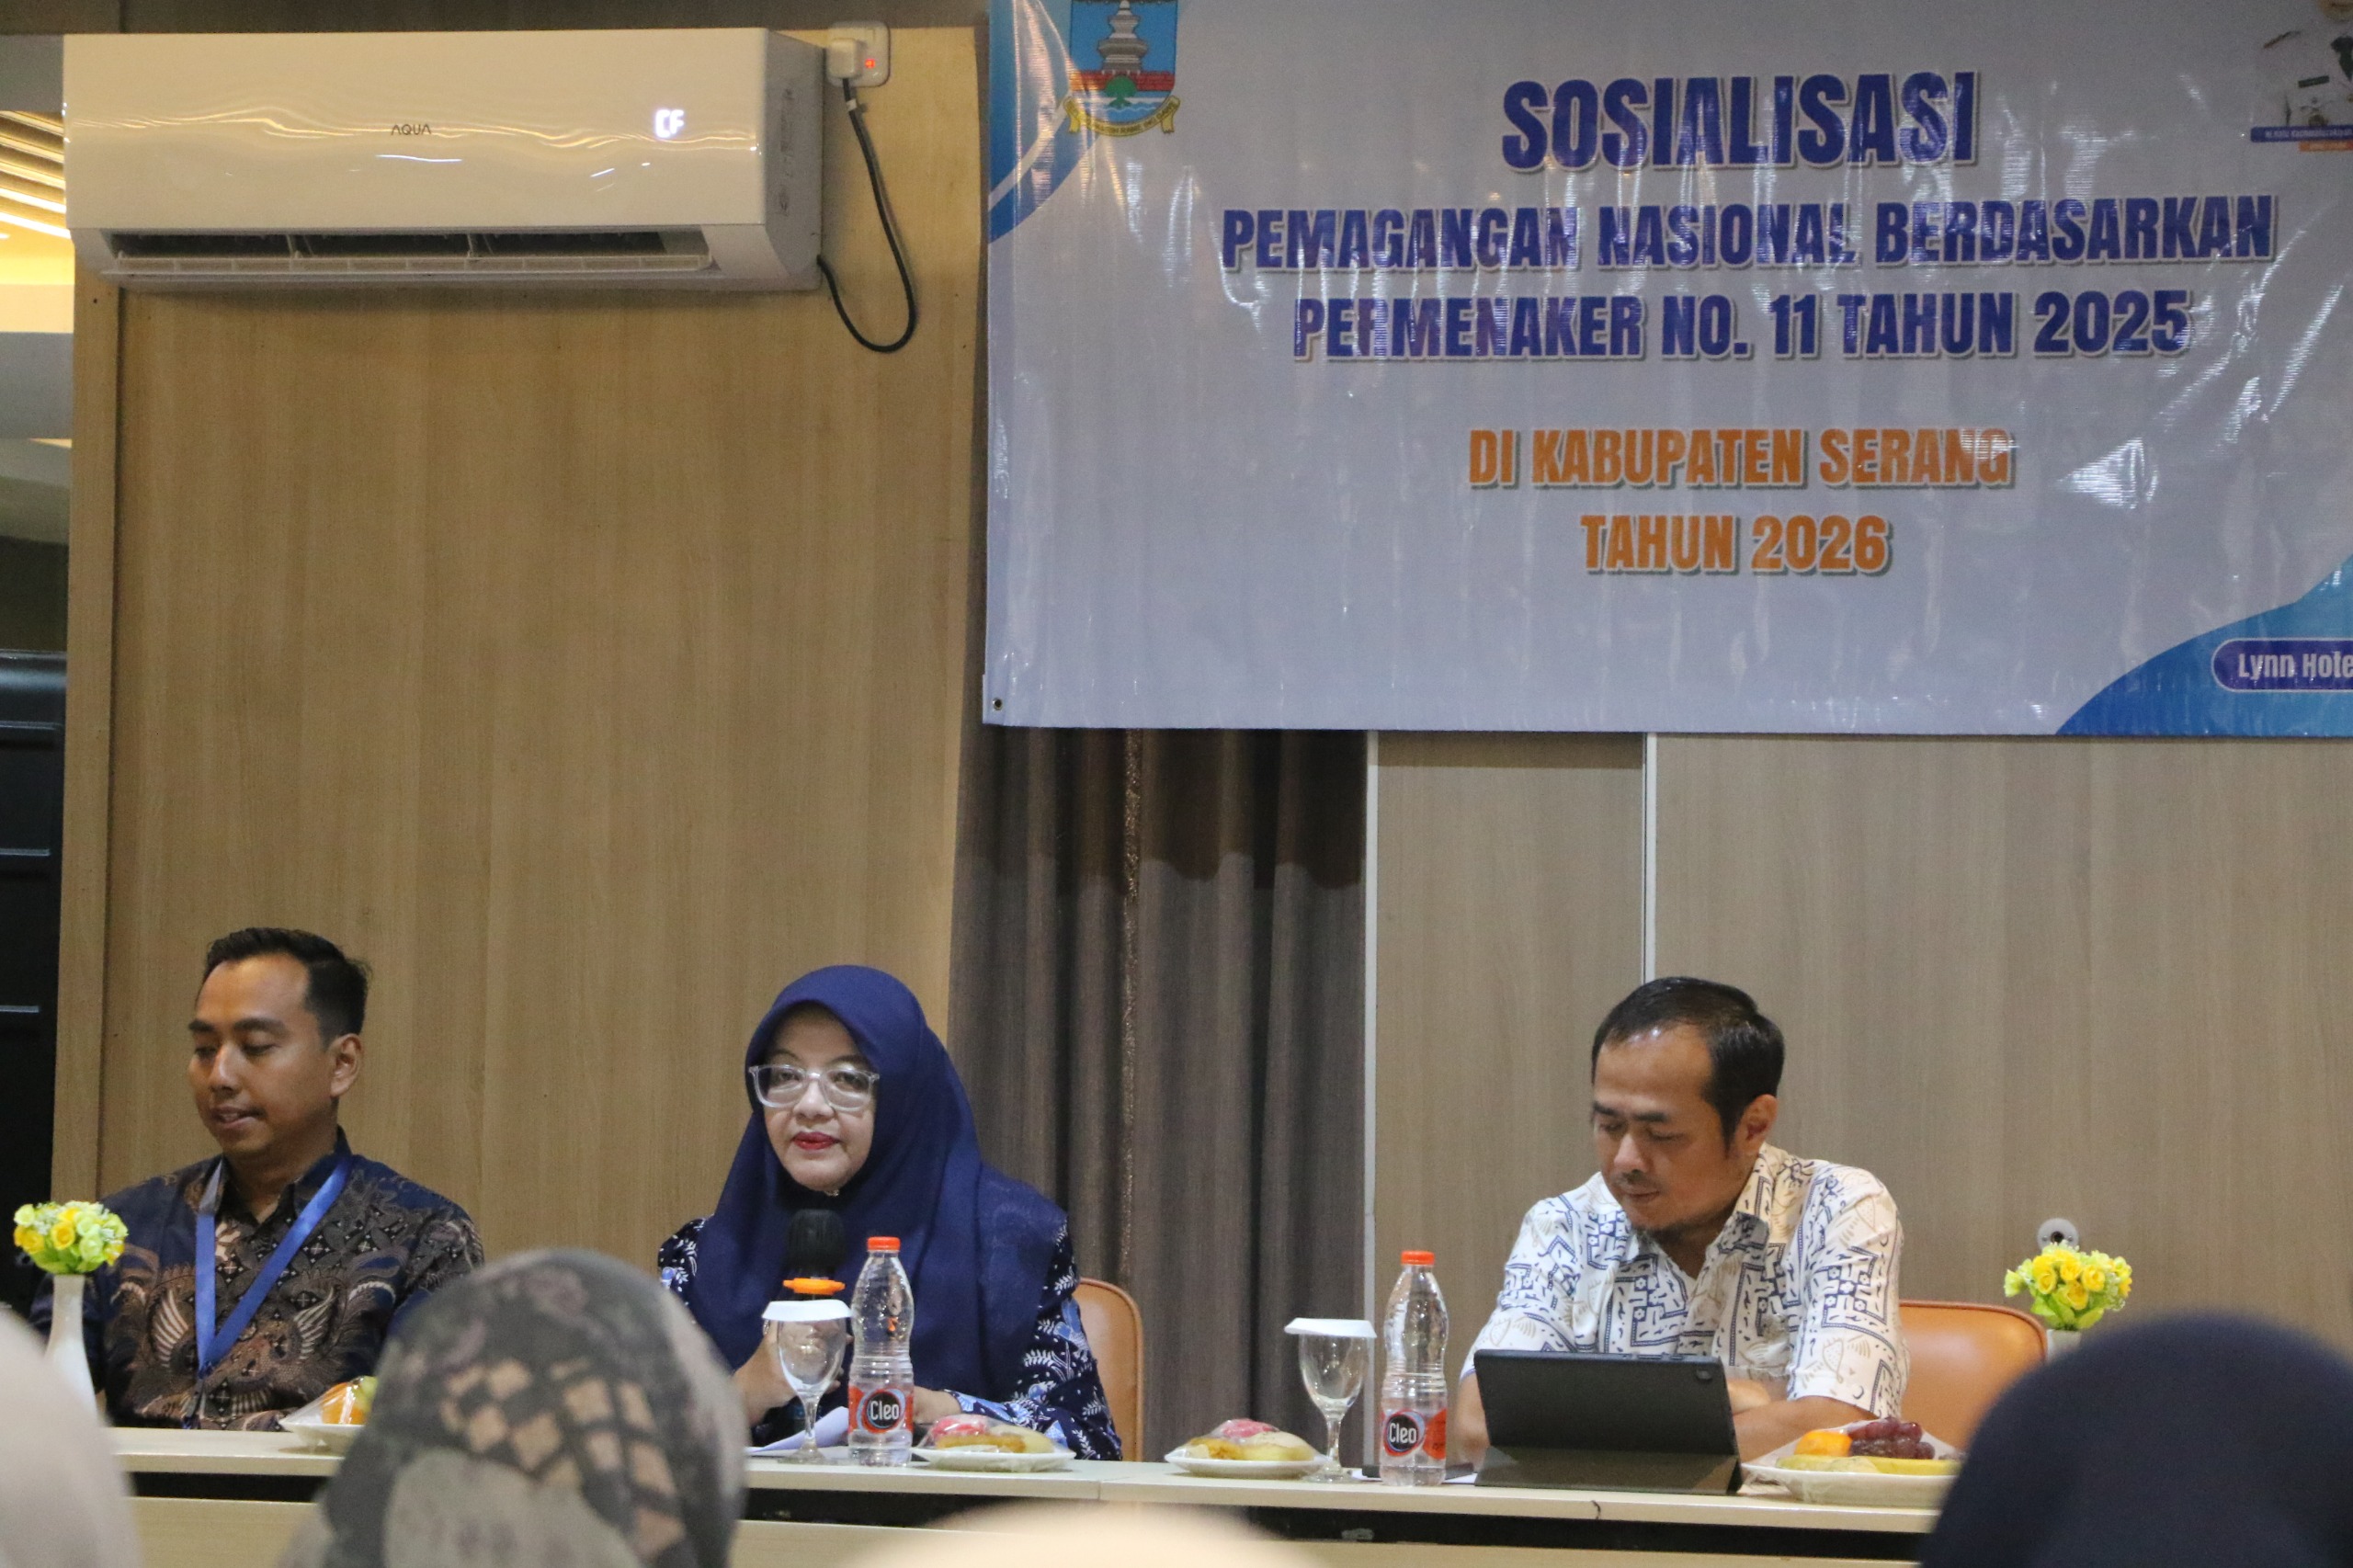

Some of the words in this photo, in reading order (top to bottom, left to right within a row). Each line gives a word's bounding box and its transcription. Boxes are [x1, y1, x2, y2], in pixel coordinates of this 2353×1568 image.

[391, 123, 432, 136] AQUA
[1501, 71, 1976, 169] SOSIALISASI
[1222, 207, 1580, 268] PEMAGANGAN
[1597, 203, 1857, 266] NASIONAL
[1876, 195, 2272, 263] BERDASARKAN
[1293, 295, 1643, 357] PERMENAKER
[1662, 294, 1749, 356] NO.
[1770, 293, 1816, 355] 11
[1837, 291, 2013, 355] TAHUN
[2032, 289, 2191, 353] 2025
[1468, 429, 1515, 484] DI
[1530, 428, 1803, 485] KABUPATEN
[1818, 428, 2012, 485] SERANG
[1580, 515, 1733, 571] TAHUN
[1750, 515, 1889, 572] 2026
[2238, 653, 2295, 681] Lynn
[870, 1400, 900, 1421] Cleo
[1389, 1423, 1417, 1444] Cleo
